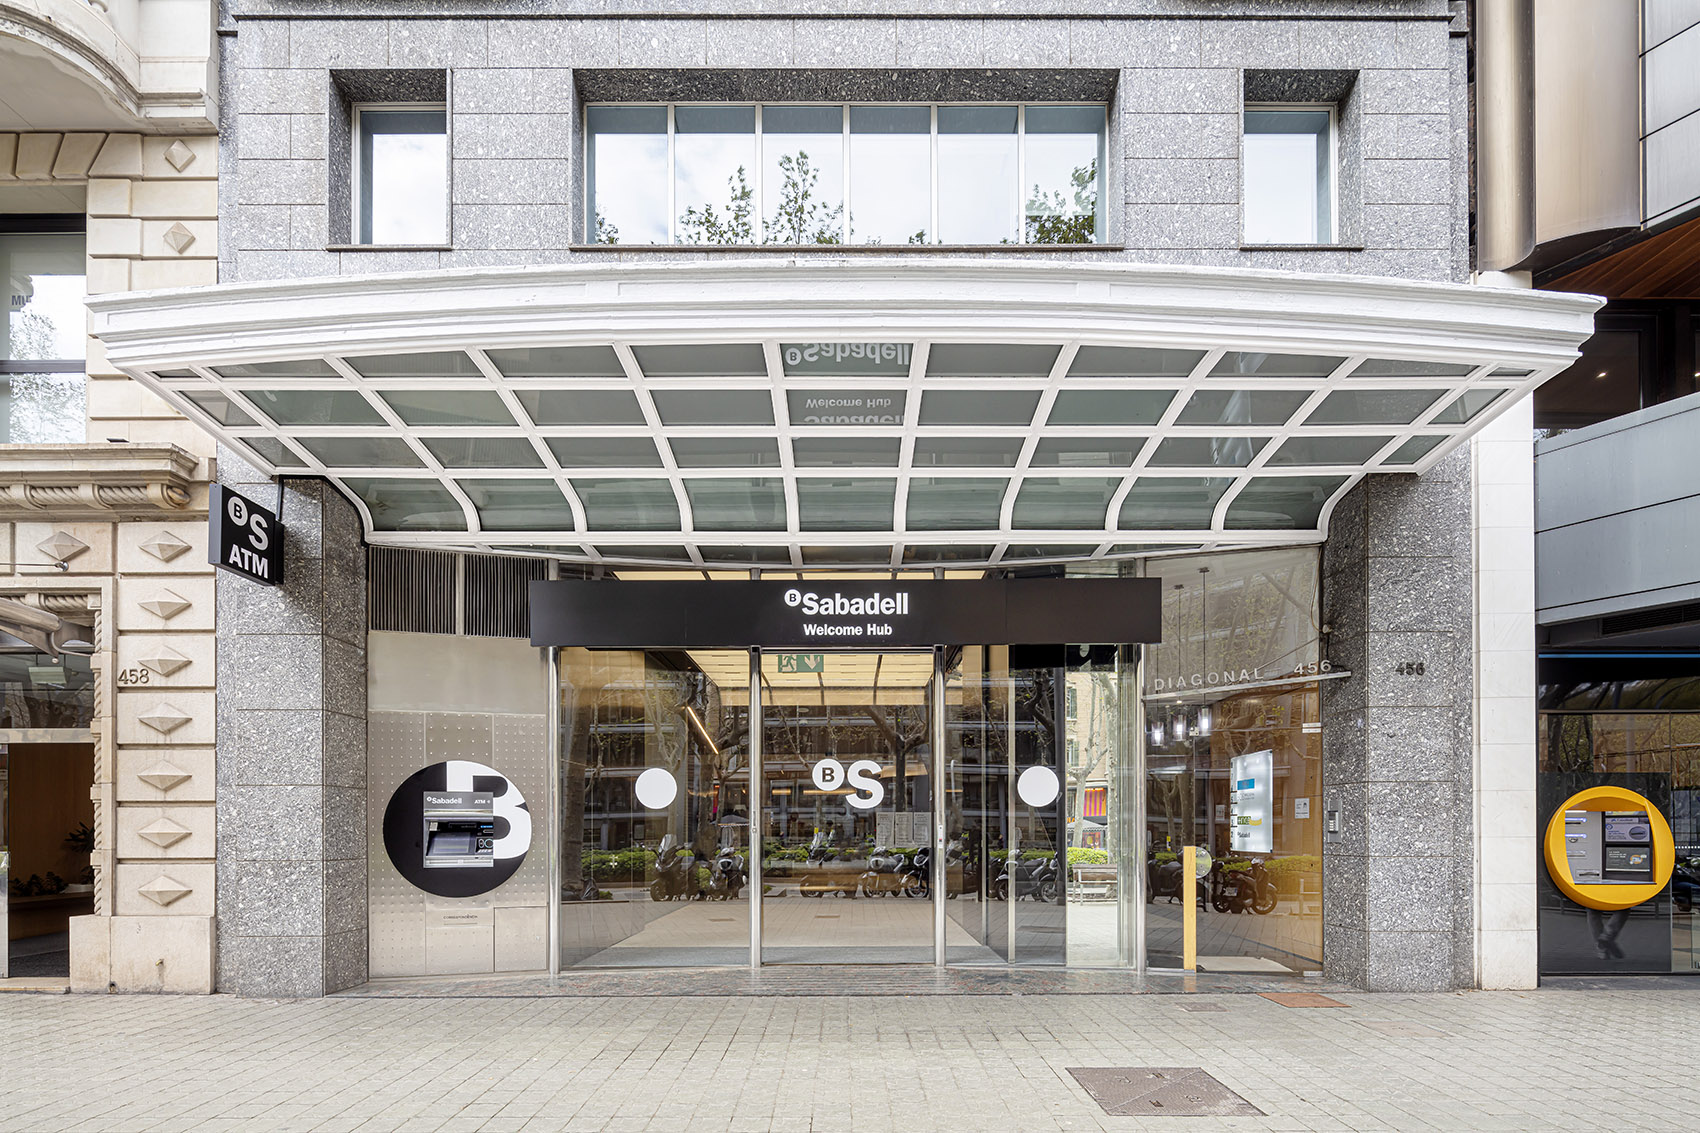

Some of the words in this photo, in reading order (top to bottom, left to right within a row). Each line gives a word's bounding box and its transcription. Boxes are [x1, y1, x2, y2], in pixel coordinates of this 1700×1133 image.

[229, 544, 268, 579] ATM
[802, 592, 909, 615] Sabadell
[803, 624, 863, 636] Welcome
[867, 624, 893, 636] Hub
[118, 668, 150, 685] 458
[1154, 668, 1264, 691] DIAGONAL
[1294, 659, 1332, 675] 456
[1395, 662, 1425, 676] 456
[431, 797, 463, 805] Sabadell
